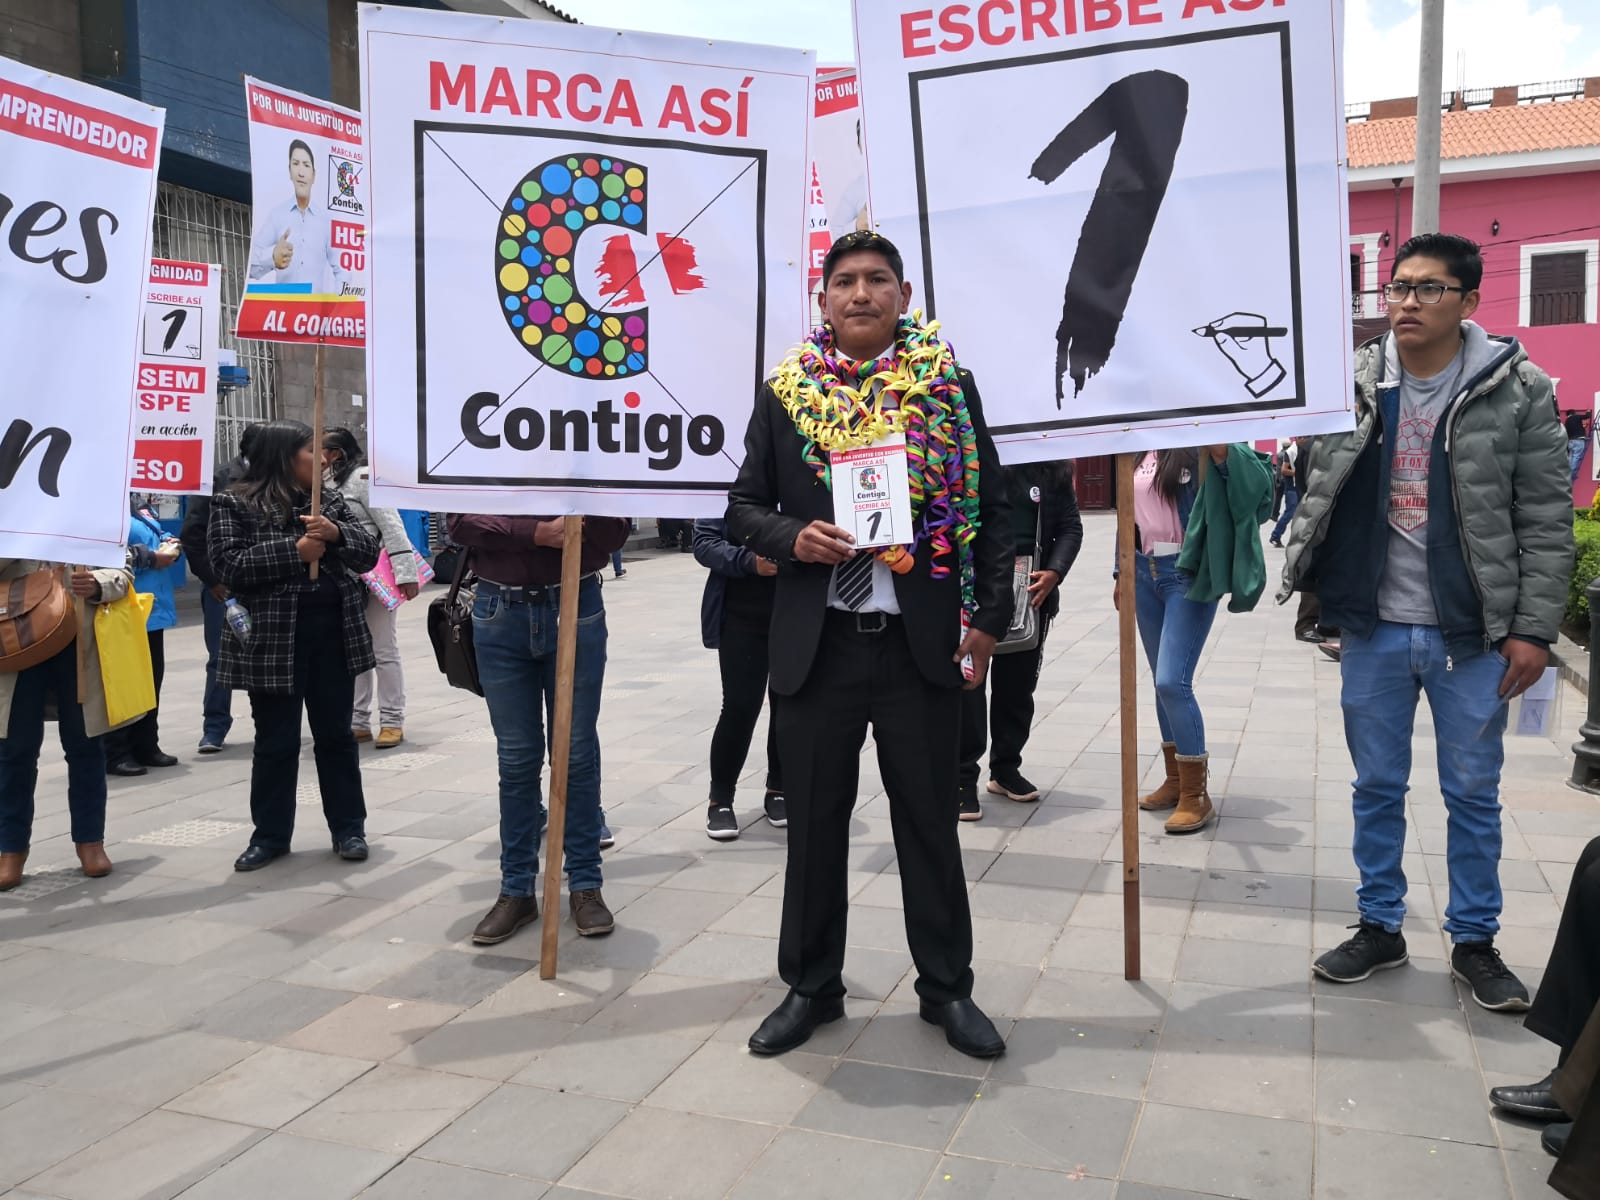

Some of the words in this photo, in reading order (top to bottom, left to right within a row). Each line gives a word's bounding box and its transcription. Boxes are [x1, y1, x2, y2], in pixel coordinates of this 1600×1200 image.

[900, 0, 1163, 58] ESCRIBE
[429, 61, 643, 127] MARCA
[658, 76, 754, 137] ASÍ
[814, 86, 834, 102] OR
[252, 92, 272, 112] POR
[274, 98, 295, 118] UNA
[297, 106, 343, 132] JUVENTUD
[0, 93, 148, 160] MPRENDEDOR
[331, 146, 352, 158] MARCA
[332, 196, 363, 212] Contigo
[0, 193, 118, 283] es
[335, 226, 364, 249] HU
[1028, 69, 1188, 410] 1
[151, 264, 203, 282] GNIDAD
[340, 252, 365, 271] QU
[186, 296, 201, 305] ASÍ
[162, 309, 187, 353] 1
[263, 310, 287, 332] AL
[293, 313, 365, 338] CONGRE
[140, 368, 199, 389] SEM
[140, 393, 190, 412] SPE
[141, 426, 155, 435] en
[159, 423, 198, 436] acción
[461, 391, 725, 471] Contigo
[133, 458, 183, 482] ESO
[854, 503, 879, 511] ESCRIBE
[857, 491, 886, 500] Contigo
[866, 511, 882, 542] 1
